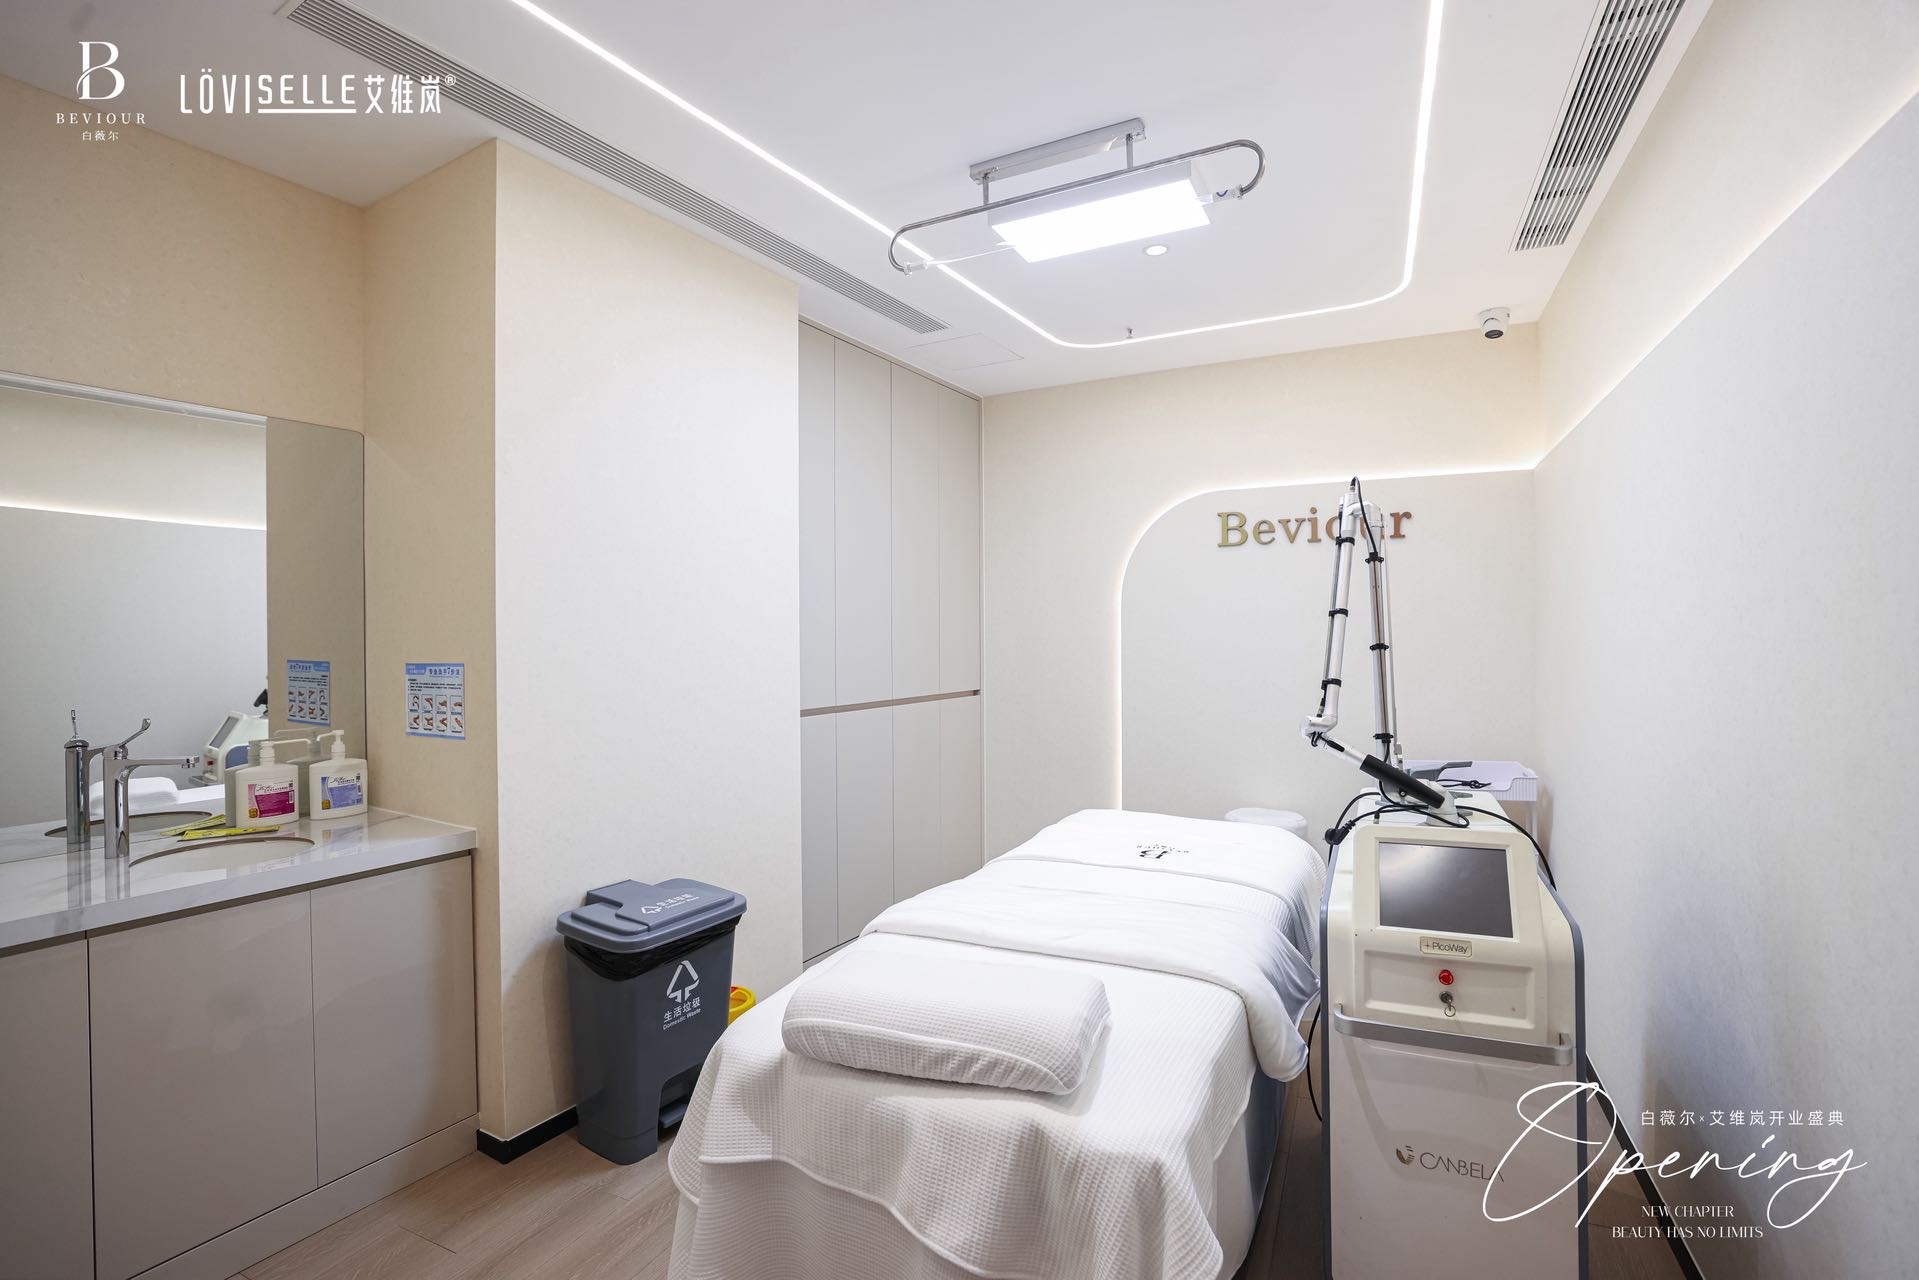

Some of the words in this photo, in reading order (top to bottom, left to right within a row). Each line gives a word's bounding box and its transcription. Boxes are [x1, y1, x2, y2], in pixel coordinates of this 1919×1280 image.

[1432, 941, 1469, 955] PicoWay
[663, 996, 701, 1023] 生活垃圾
